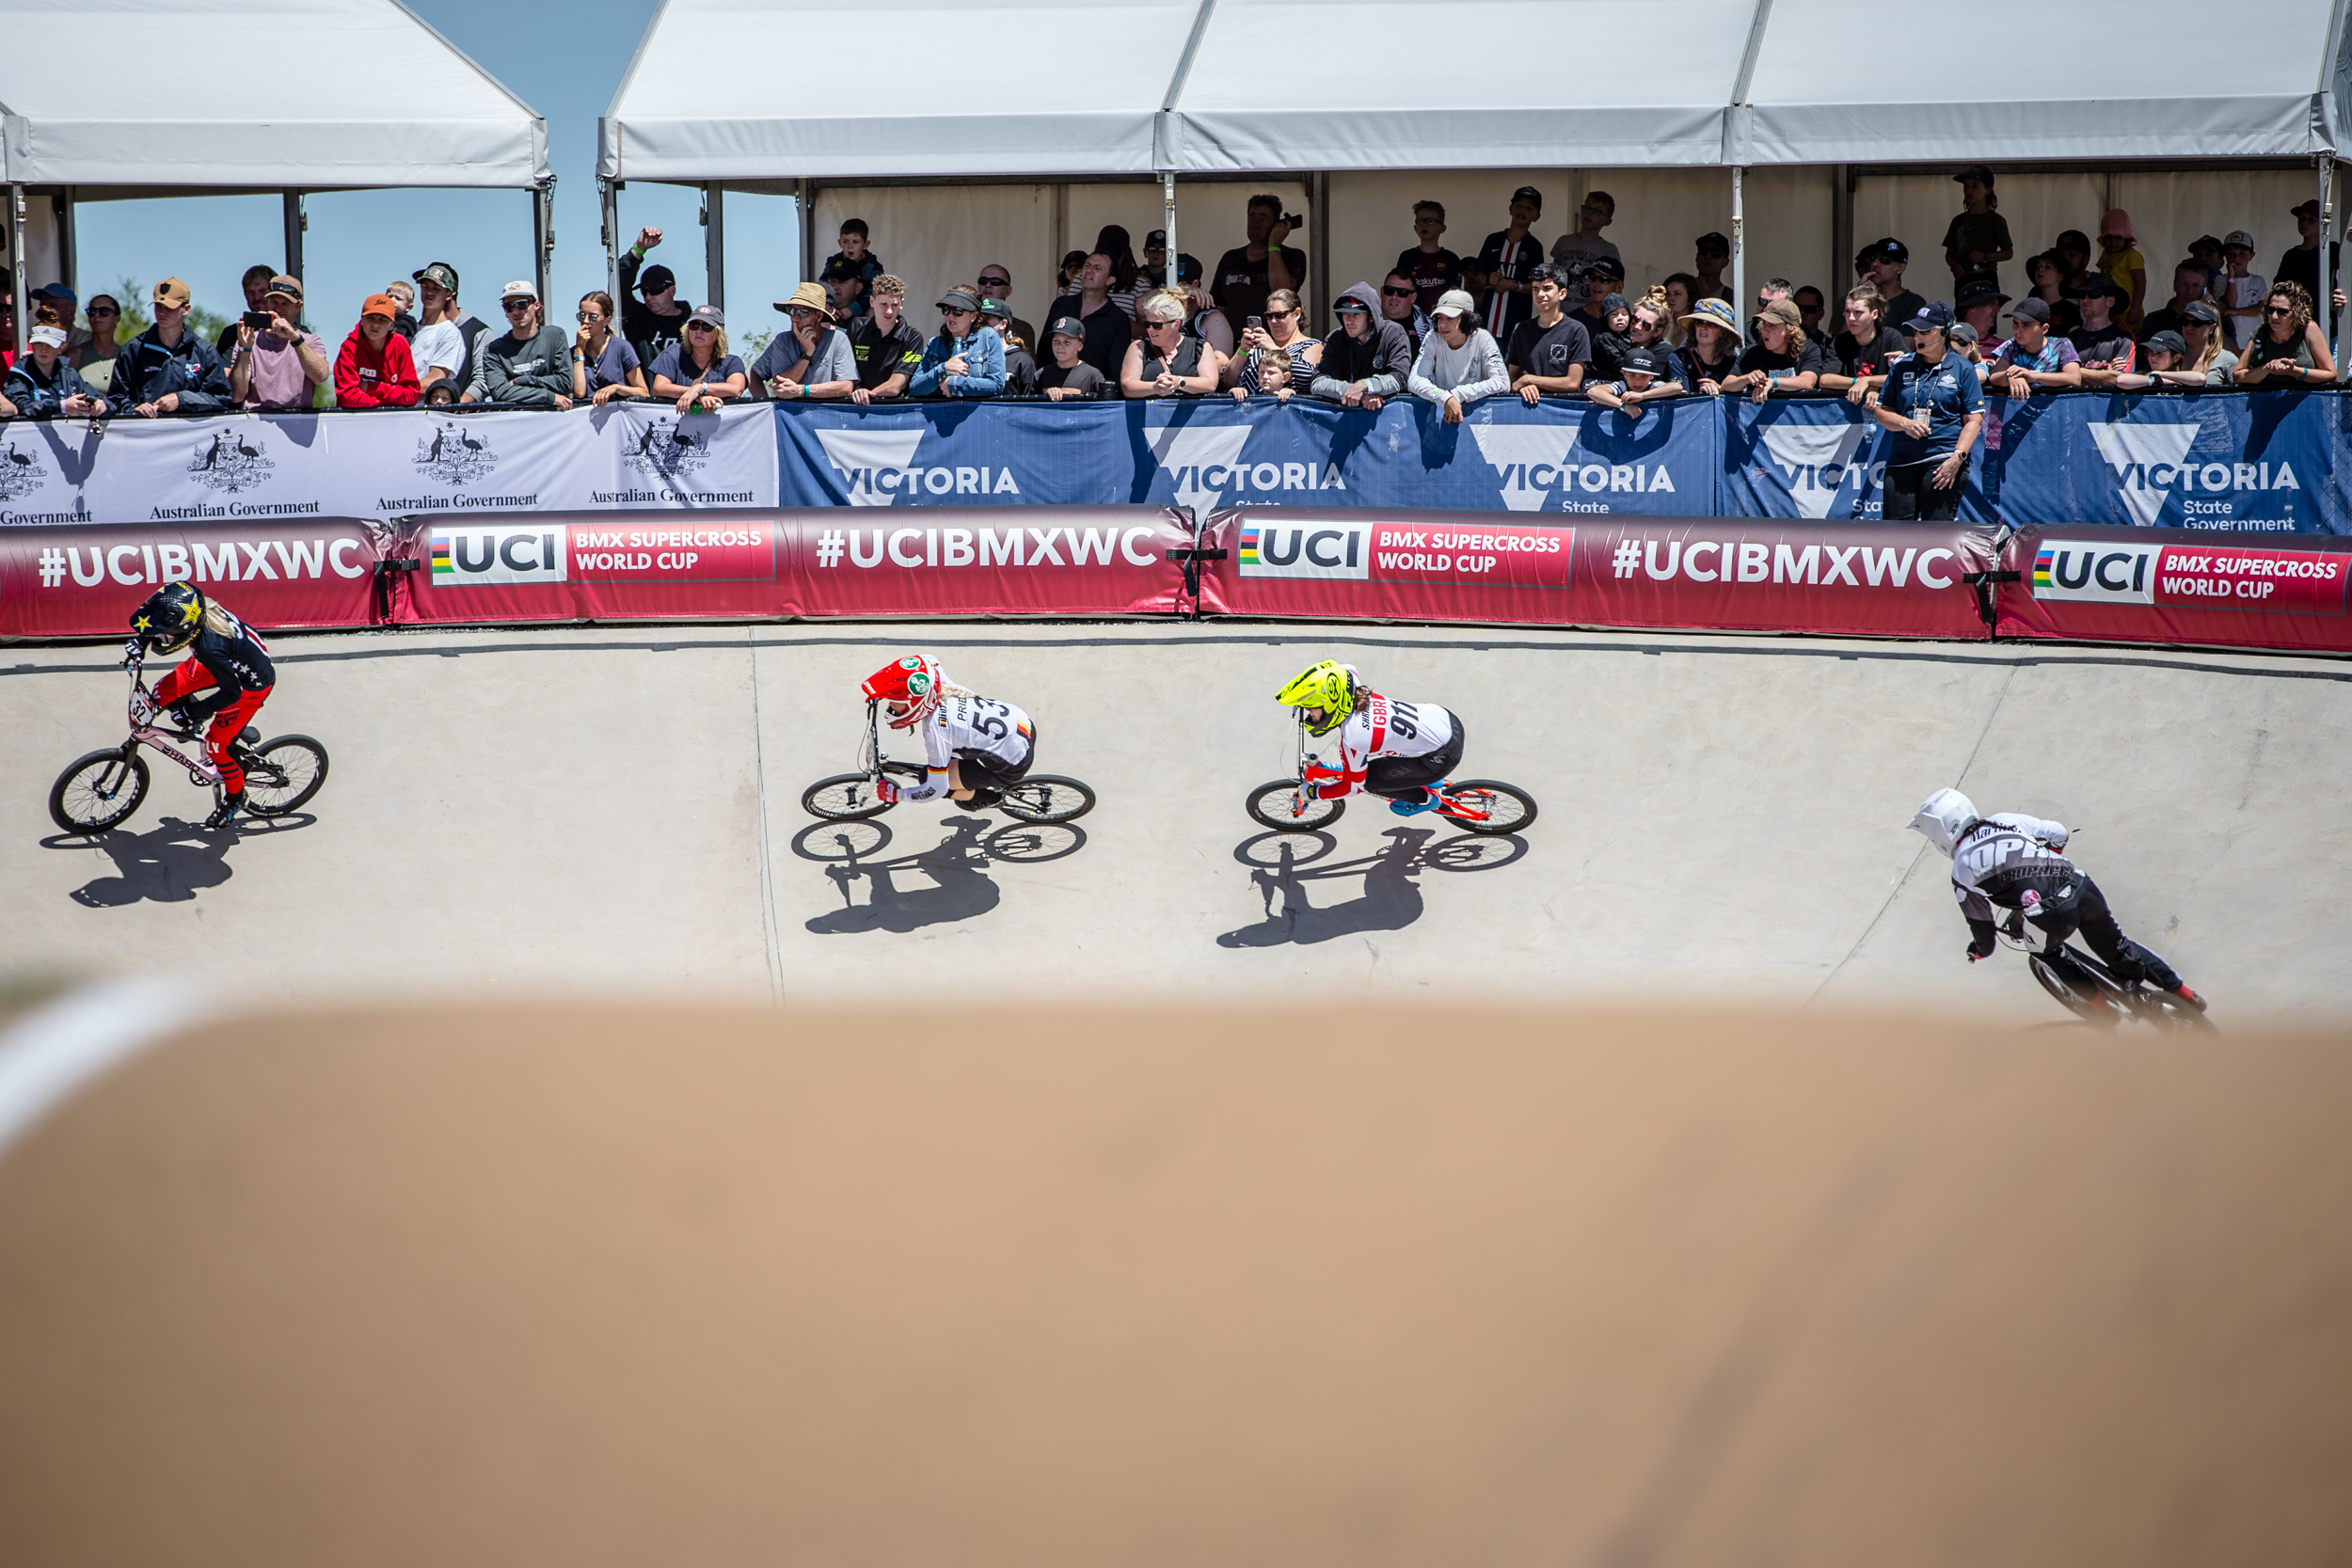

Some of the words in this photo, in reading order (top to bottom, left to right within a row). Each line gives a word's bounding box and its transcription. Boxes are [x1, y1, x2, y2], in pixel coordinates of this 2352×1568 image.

[832, 467, 1020, 495] VICTORIA
[1167, 462, 1346, 493] VICTORIA
[1496, 463, 1676, 493] VICTORIA
[1775, 461, 1885, 491] VICTO
[2105, 461, 2300, 491] VICTORIA
[375, 494, 449, 511] Australian
[453, 492, 538, 509] Government
[589, 489, 656, 503] Australian
[660, 487, 754, 503] Government
[1562, 500, 1610, 514] State
[2184, 499, 2233, 515] State
[1, 510, 92, 525] Government
[150, 503, 225, 520] Australian
[229, 499, 320, 517] Government
[2184, 515, 2296, 531] Government
[576, 532, 623, 548] BMX
[629, 530, 762, 548] SUPERCROSS
[817, 526, 1158, 568] #UCIBMXWC
[1262, 528, 1360, 568] UCI
[1379, 531, 1426, 548] BMX
[1431, 531, 1561, 553] SUPERCROSS
[39, 537, 365, 588] #UCIBMXWC
[455, 533, 555, 572] UCI
[576, 552, 652, 570] WORLD
[657, 551, 699, 570] CUP
[1378, 551, 1451, 571] WORLD
[1455, 554, 1497, 574] CUP
[1612, 539, 1954, 589] #UCIBMXWC
[2053, 549, 2149, 593] UCI
[2165, 554, 2211, 573] BMX
[2213, 557, 2338, 579] SUPERCROSS
[2162, 576, 2233, 596] WORLD
[2235, 580, 2275, 599] CUP
[132, 700, 147, 722] 32
[1373, 698, 1387, 726] GBR
[1390, 698, 1419, 740] 911
